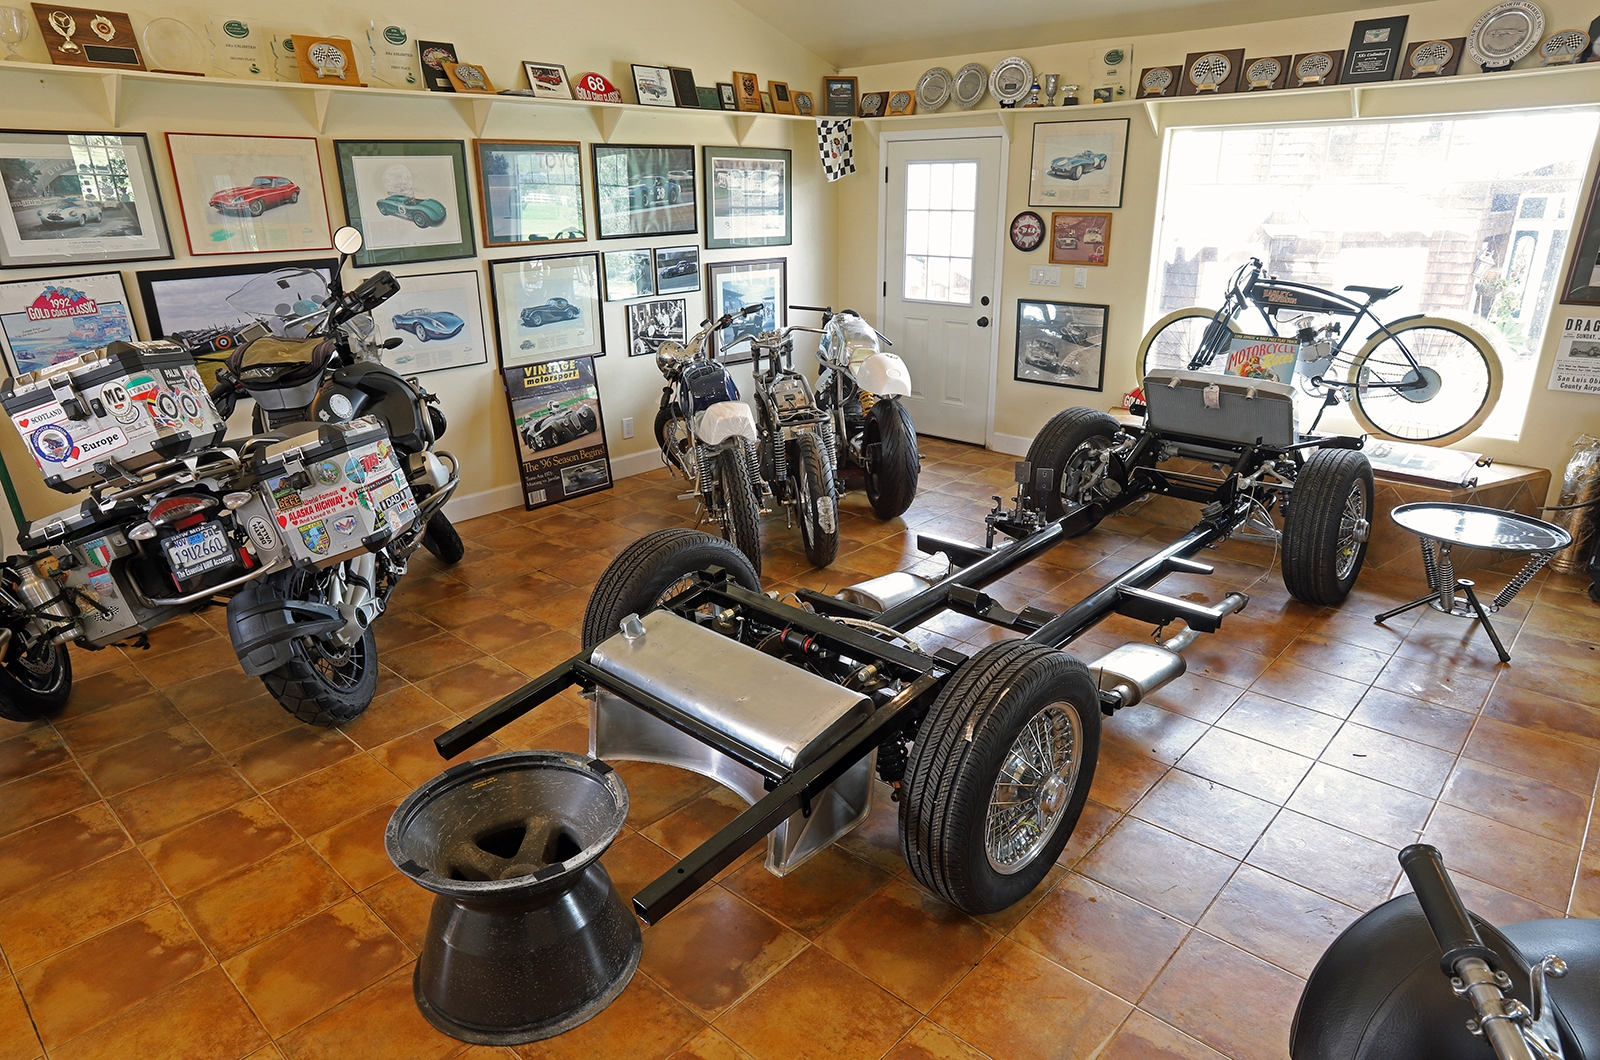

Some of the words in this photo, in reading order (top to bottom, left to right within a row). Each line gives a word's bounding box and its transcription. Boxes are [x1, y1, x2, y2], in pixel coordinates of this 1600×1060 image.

[1501, 1, 1521, 9] NORTH
[1524, 2, 1541, 20] AMERICA
[587, 75, 605, 92] 68
[577, 86, 592, 100] GOLD
[60, 275, 116, 284] MAGAZINE
[28, 307, 51, 320] GOLD
[51, 308, 69, 318] COAST
[69, 300, 96, 315] CLASSIC
[50, 297, 71, 309] 1992
[1228, 343, 1296, 371] MOTORCYCLE
[1262, 354, 1294, 369] Races
[524, 360, 576, 377] VINTAGE
[527, 371, 577, 385] motorsport
[1557, 374, 1570, 382] San
[1560, 382, 1581, 390] County
[103, 386, 125, 405] MC
[30, 408, 62, 424] SCOTLAND
[81, 433, 119, 453] Europe
[523, 462, 539, 472] The
[540, 458, 552, 469] '96
[553, 454, 579, 466] Season
[580, 445, 606, 460] Begins!
[279, 499, 302, 509] REEF
[303, 496, 318, 505] World
[319, 490, 339, 500] Famous
[386, 494, 400, 507] DAD
[288, 505, 315, 521] ALASKA
[314, 494, 344, 512] HIGHWAY
[299, 516, 310, 524] And
[310, 512, 326, 520] Loved
[171, 532, 188, 541] BMW
[202, 528, 219, 539] CAL
[252, 523, 267, 545] DEATH
[256, 521, 273, 545] VALLEY
[86, 540, 105, 550] ITALIA
[173, 538, 186, 548] NOV
[174, 537, 223, 565] 19U2660
[176, 570, 186, 578] The
[185, 565, 203, 577] Essential
[213, 553, 235, 567] Accessory
